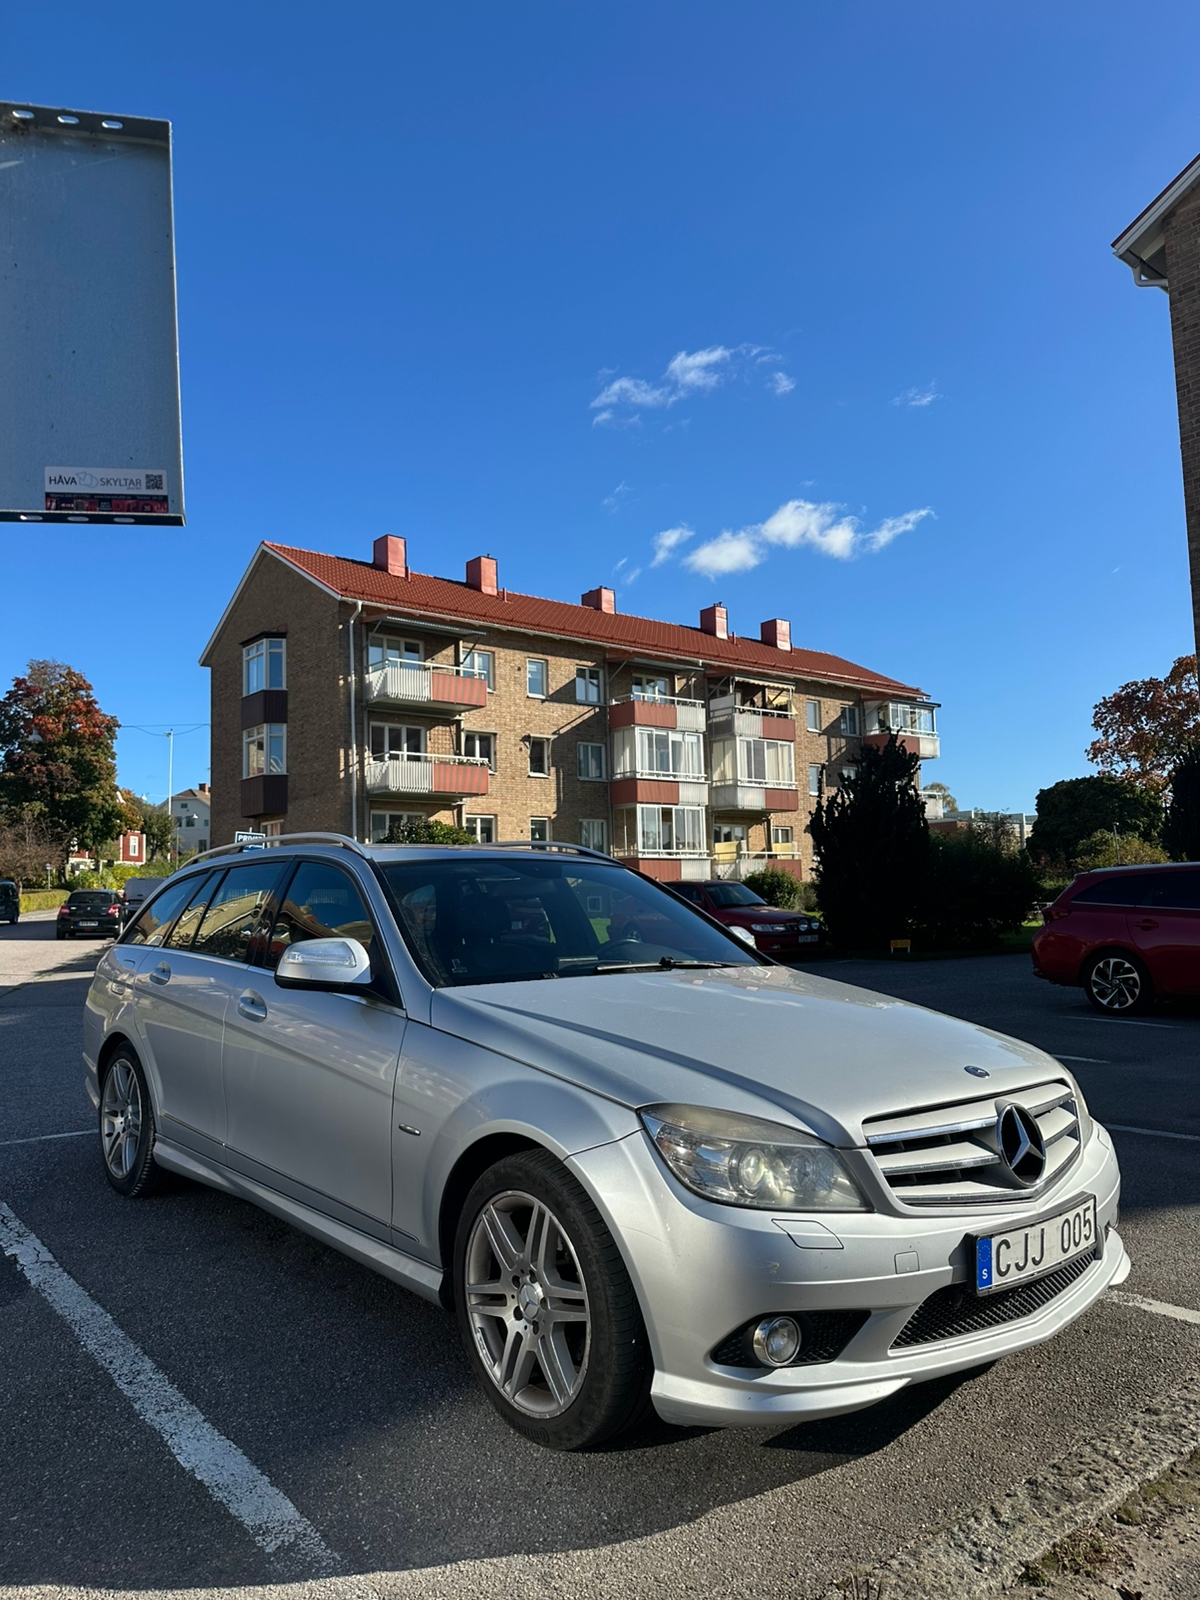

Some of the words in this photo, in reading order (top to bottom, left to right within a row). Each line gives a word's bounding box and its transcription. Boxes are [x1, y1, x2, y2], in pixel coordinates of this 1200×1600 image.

[49, 475, 77, 486] HÅVA
[100, 477, 142, 487] SKYLTAR
[996, 1226, 1045, 1277] CJJ
[1061, 1205, 1092, 1254] 005
[982, 1268, 989, 1280] S
